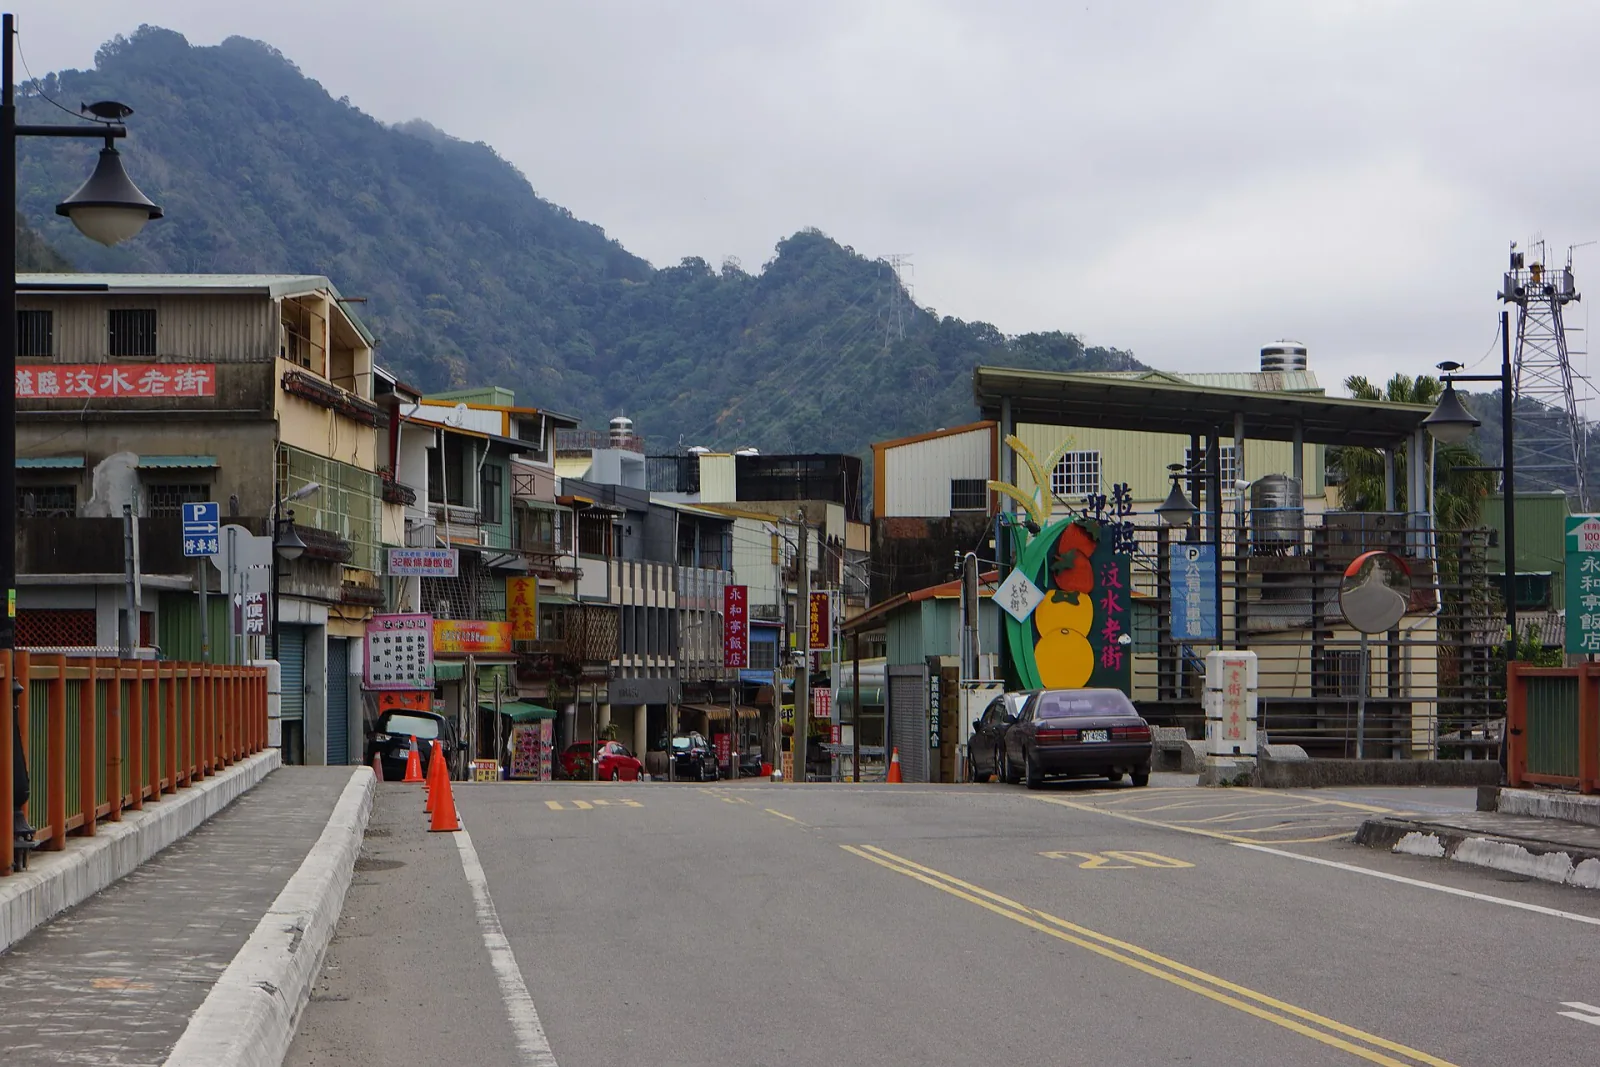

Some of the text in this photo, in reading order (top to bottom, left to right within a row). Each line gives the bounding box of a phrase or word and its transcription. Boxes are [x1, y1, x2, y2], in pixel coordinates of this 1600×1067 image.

[185, 538, 218, 554] 停車場
[193, 505, 207, 521] P
[1189, 549, 1197, 560] P
[729, 587, 742, 666] 永和亭飯店
[1100, 562, 1124, 671] 汶水老街
[1185, 562, 1202, 636] 公有停車場
[1580, 556, 1600, 651] 永和亭飯店
[931, 675, 939, 732] 東西向快速公路
[1228, 670, 1241, 738] 老街停車場
